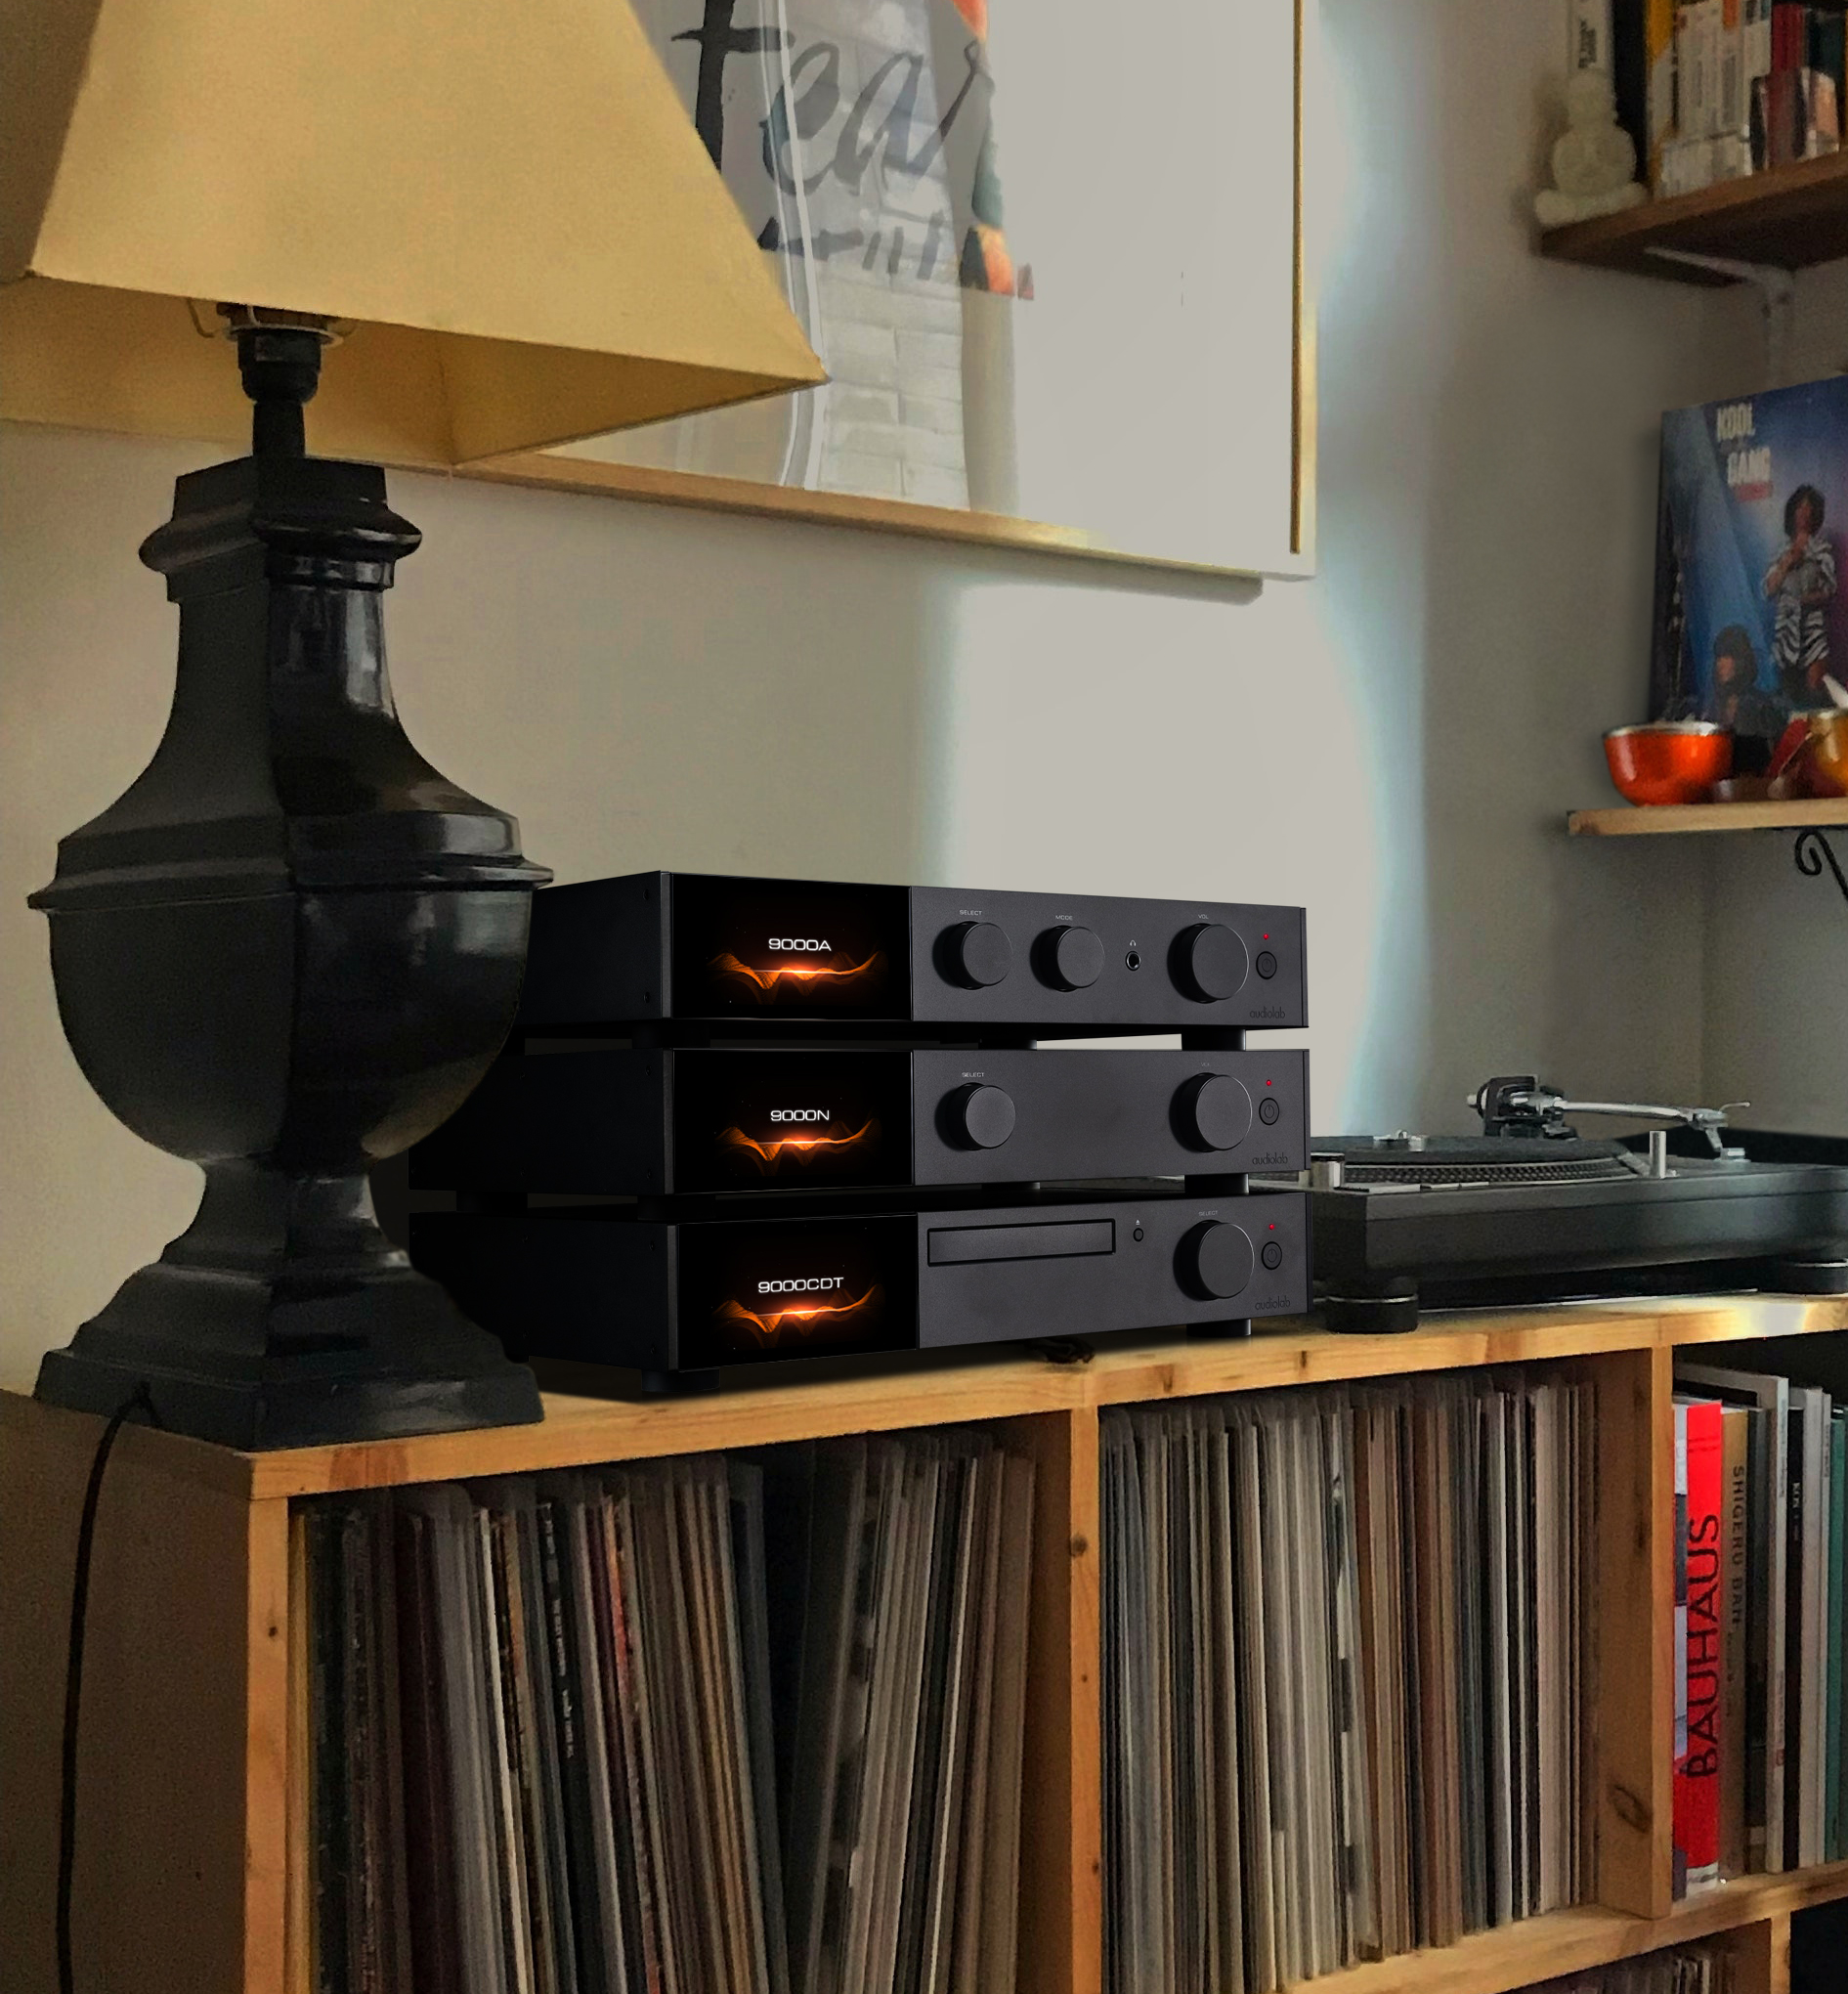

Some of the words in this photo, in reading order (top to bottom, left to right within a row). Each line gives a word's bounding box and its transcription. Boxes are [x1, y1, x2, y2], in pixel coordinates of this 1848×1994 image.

[1717, 403, 1755, 442] KOOL
[768, 937, 832, 952] 9000A
[1249, 1005, 1286, 1019] audiolab
[770, 1109, 830, 1122] 9000N
[1252, 1151, 1289, 1165] audiolab
[757, 1277, 844, 1294] 9000CDT
[1254, 1294, 1291, 1311] audiolab
[1732, 1465, 1745, 1566] SHIGERU
[1687, 1513, 1719, 1778] BAUHAUS
